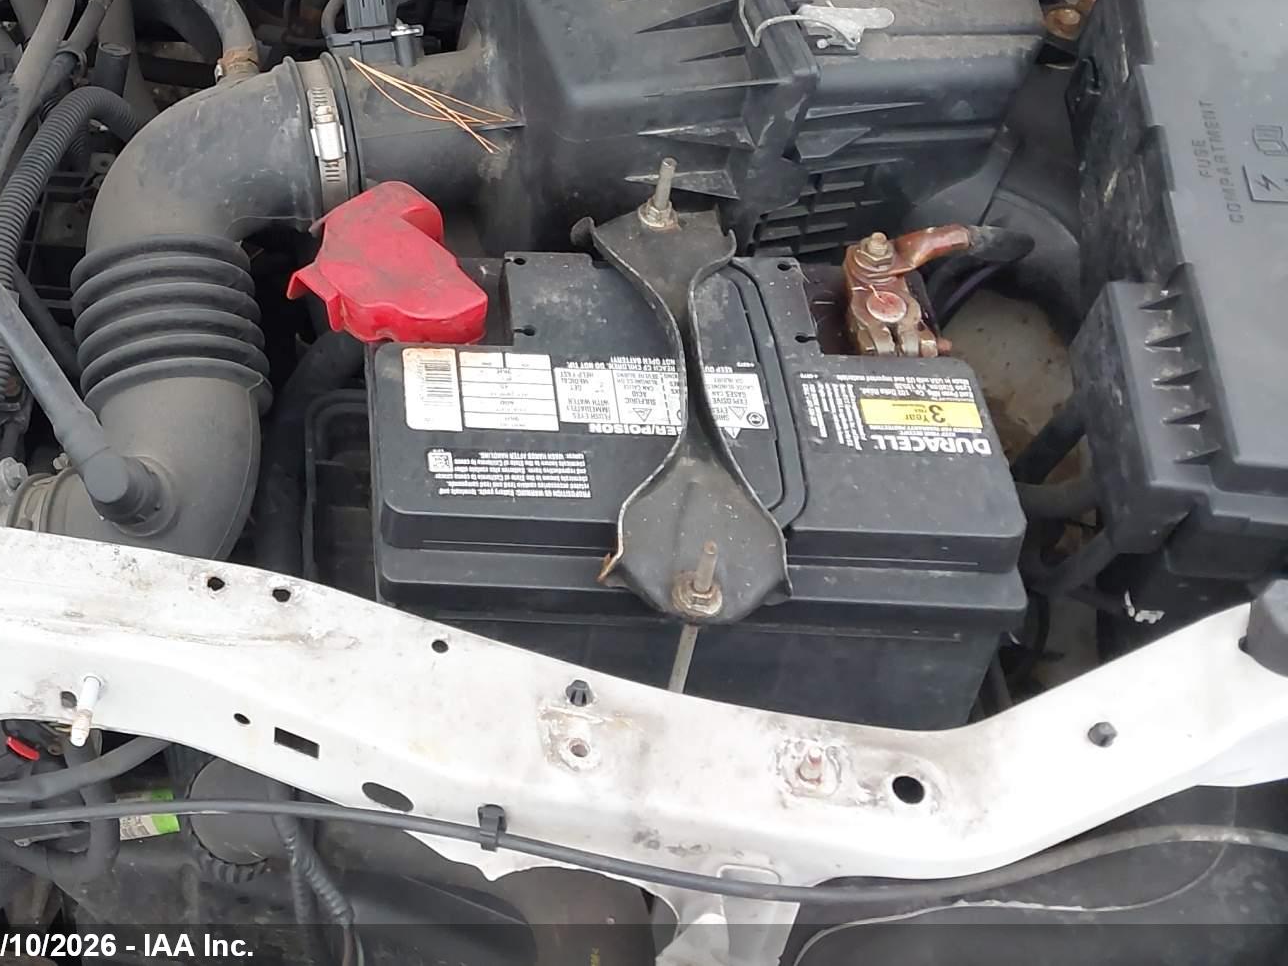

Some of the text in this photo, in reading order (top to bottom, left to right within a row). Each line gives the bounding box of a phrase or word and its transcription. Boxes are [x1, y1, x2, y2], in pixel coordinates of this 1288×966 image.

[905, 404, 945, 423] 3 Year
[870, 434, 992, 455] DURACELL
